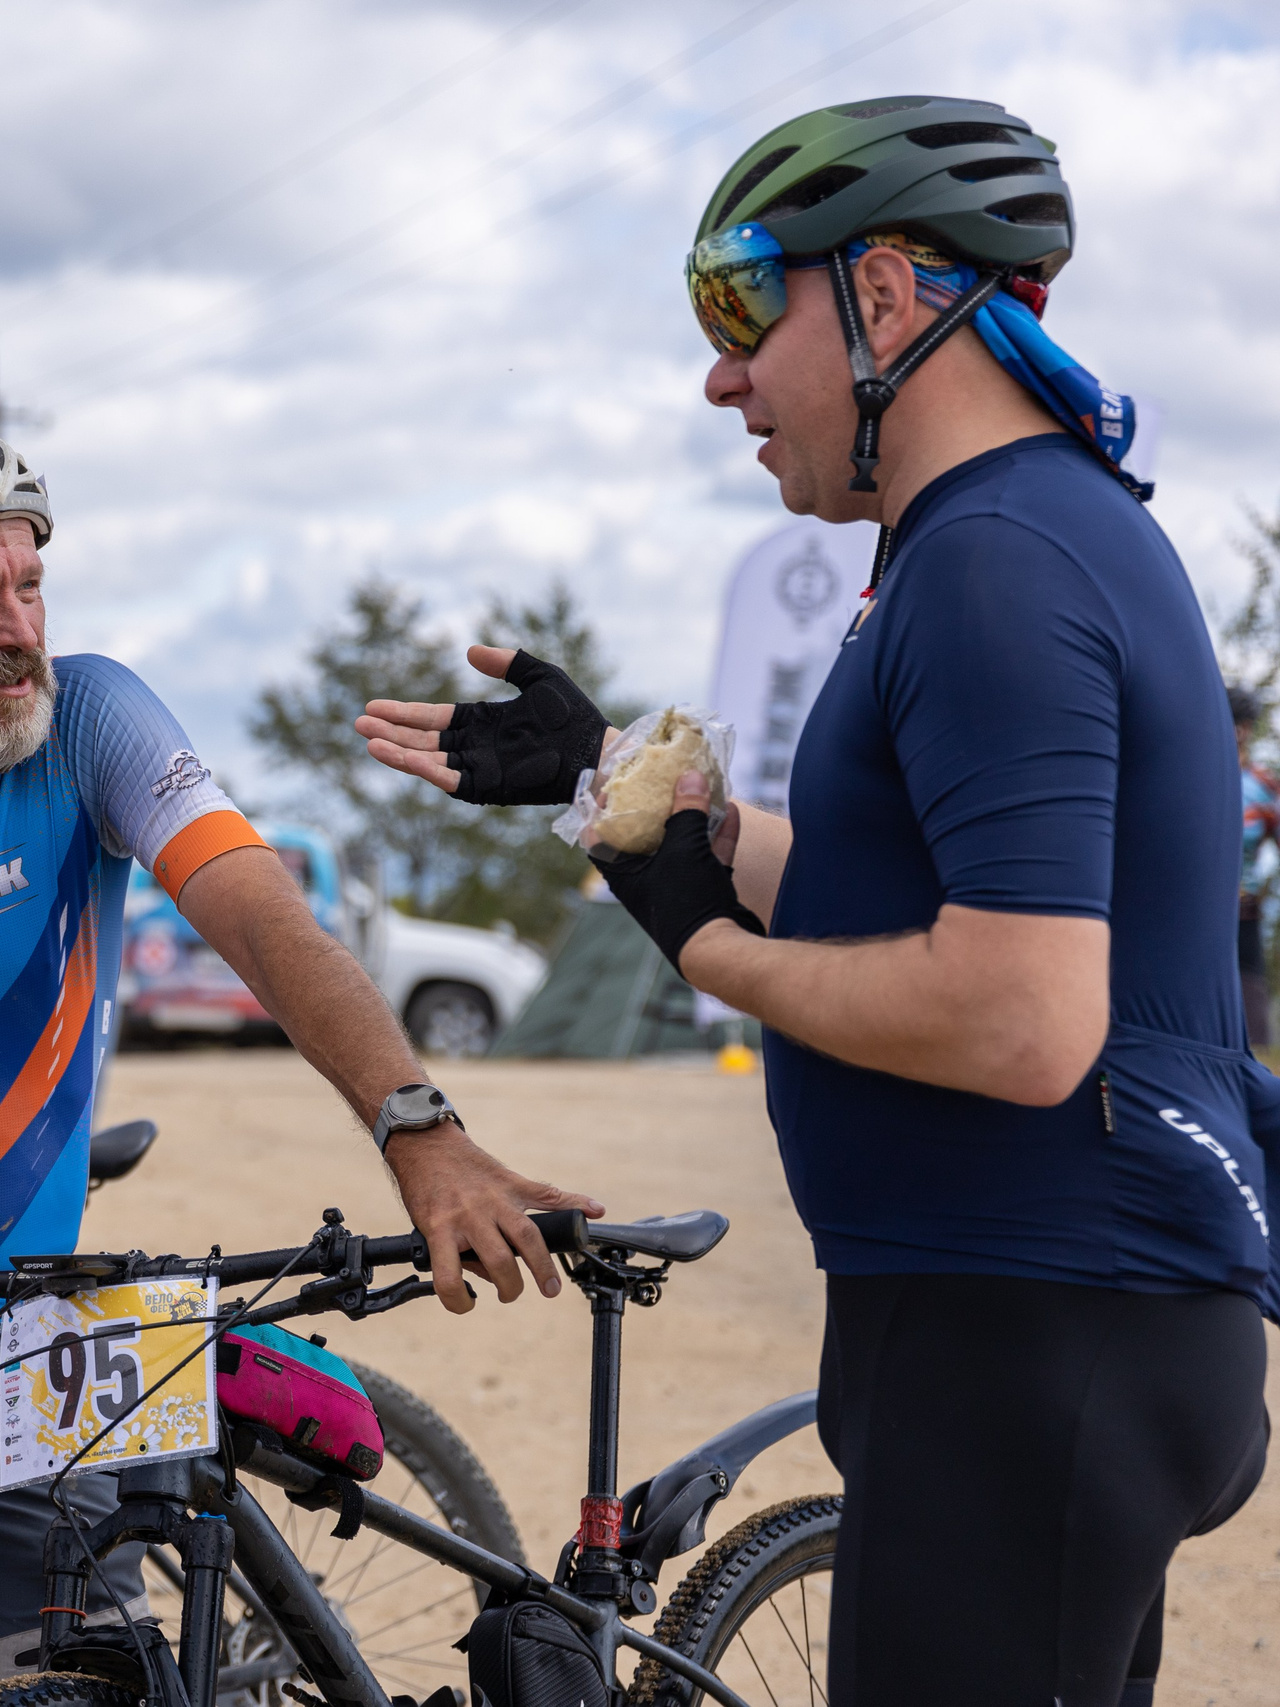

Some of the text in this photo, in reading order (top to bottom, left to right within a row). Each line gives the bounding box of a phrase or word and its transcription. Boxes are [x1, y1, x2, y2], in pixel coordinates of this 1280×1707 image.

[1158, 1108, 1270, 1246] UPLAN
[145, 1293, 173, 1306] ВЕЛО
[48, 1321, 139, 1431] 95
